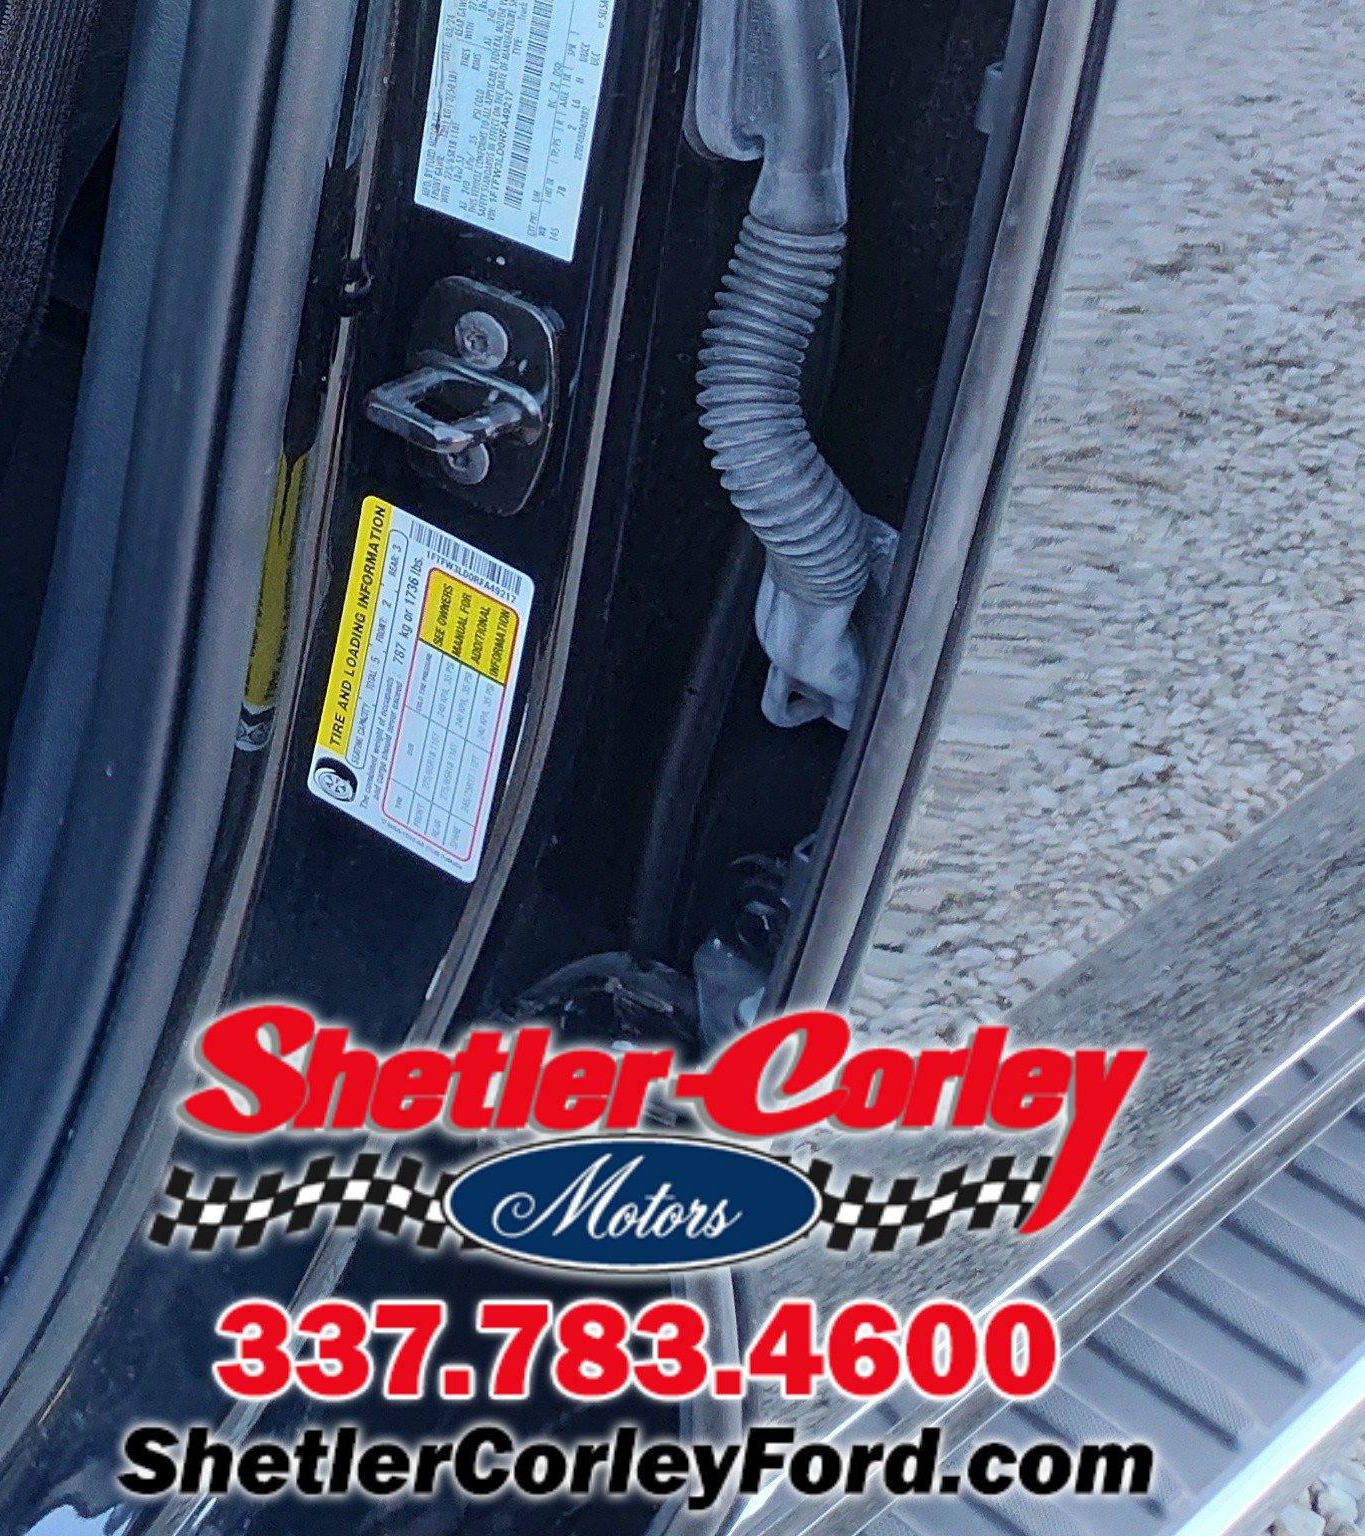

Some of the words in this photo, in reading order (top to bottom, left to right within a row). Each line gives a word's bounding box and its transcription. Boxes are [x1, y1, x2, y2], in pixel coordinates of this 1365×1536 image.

[494, 5, 507, 33] MOTOR
[516, 0, 528, 21] Truck
[463, 19, 475, 40] WITH
[500, 7, 517, 61] MANUFACTURE
[489, 32, 503, 64] FEDERAL
[499, 60, 508, 71] OF
[483, 64, 497, 106] APPLICABLE
[496, 71, 507, 90] DATE
[473, 87, 484, 108] COLD
[494, 90, 504, 105] THE
[471, 106, 482, 120] PSI
[480, 104, 492, 119] ALL
[492, 104, 502, 117] ON
[479, 118, 489, 130] TO
[488, 117, 500, 142] EFFECT
[468, 133, 477, 145] 35
[487, 142, 496, 152] IN
[425, 147, 436, 168] FORD
[470, 169, 482, 198] VEHICLE
[480, 150, 495, 193] STANDARDS
[467, 197, 478, 214] THIS
[477, 193, 488, 218] SAFETY
[548, 225, 560, 242] 145
[355, 503, 387, 610] INFORMATION
[410, 552, 424, 577] lbs.
[369, 654, 380, 665] 5
[381, 597, 392, 609] 2
[391, 541, 402, 553] 3
[403, 574, 420, 607] 1736
[401, 606, 413, 622] or
[435, 581, 454, 627] OWNERS
[397, 620, 413, 641] kg
[432, 625, 446, 648] SEE
[450, 612, 468, 658] MANUAL
[459, 590, 472, 615] FOR
[469, 602, 491, 665] ADDITIONAL
[342, 609, 366, 678] LOADING
[392, 640, 407, 666] 787
[487, 607, 511, 678] INFORMATION
[336, 677, 353, 712] AND
[378, 673, 396, 718] occupants
[390, 679, 403, 710] exceed
[328, 710, 346, 749] TIRE
[376, 715, 386, 727] of
[387, 709, 397, 733] never
[370, 724, 386, 755] weight
[380, 732, 392, 761] should
[362, 753, 378, 795] combined
[376, 760, 388, 786] cargo
[359, 792, 370, 810] The
[372, 783, 382, 802] and
[412, 801, 425, 829] FRONT
[431, 817, 442, 839] REAR
